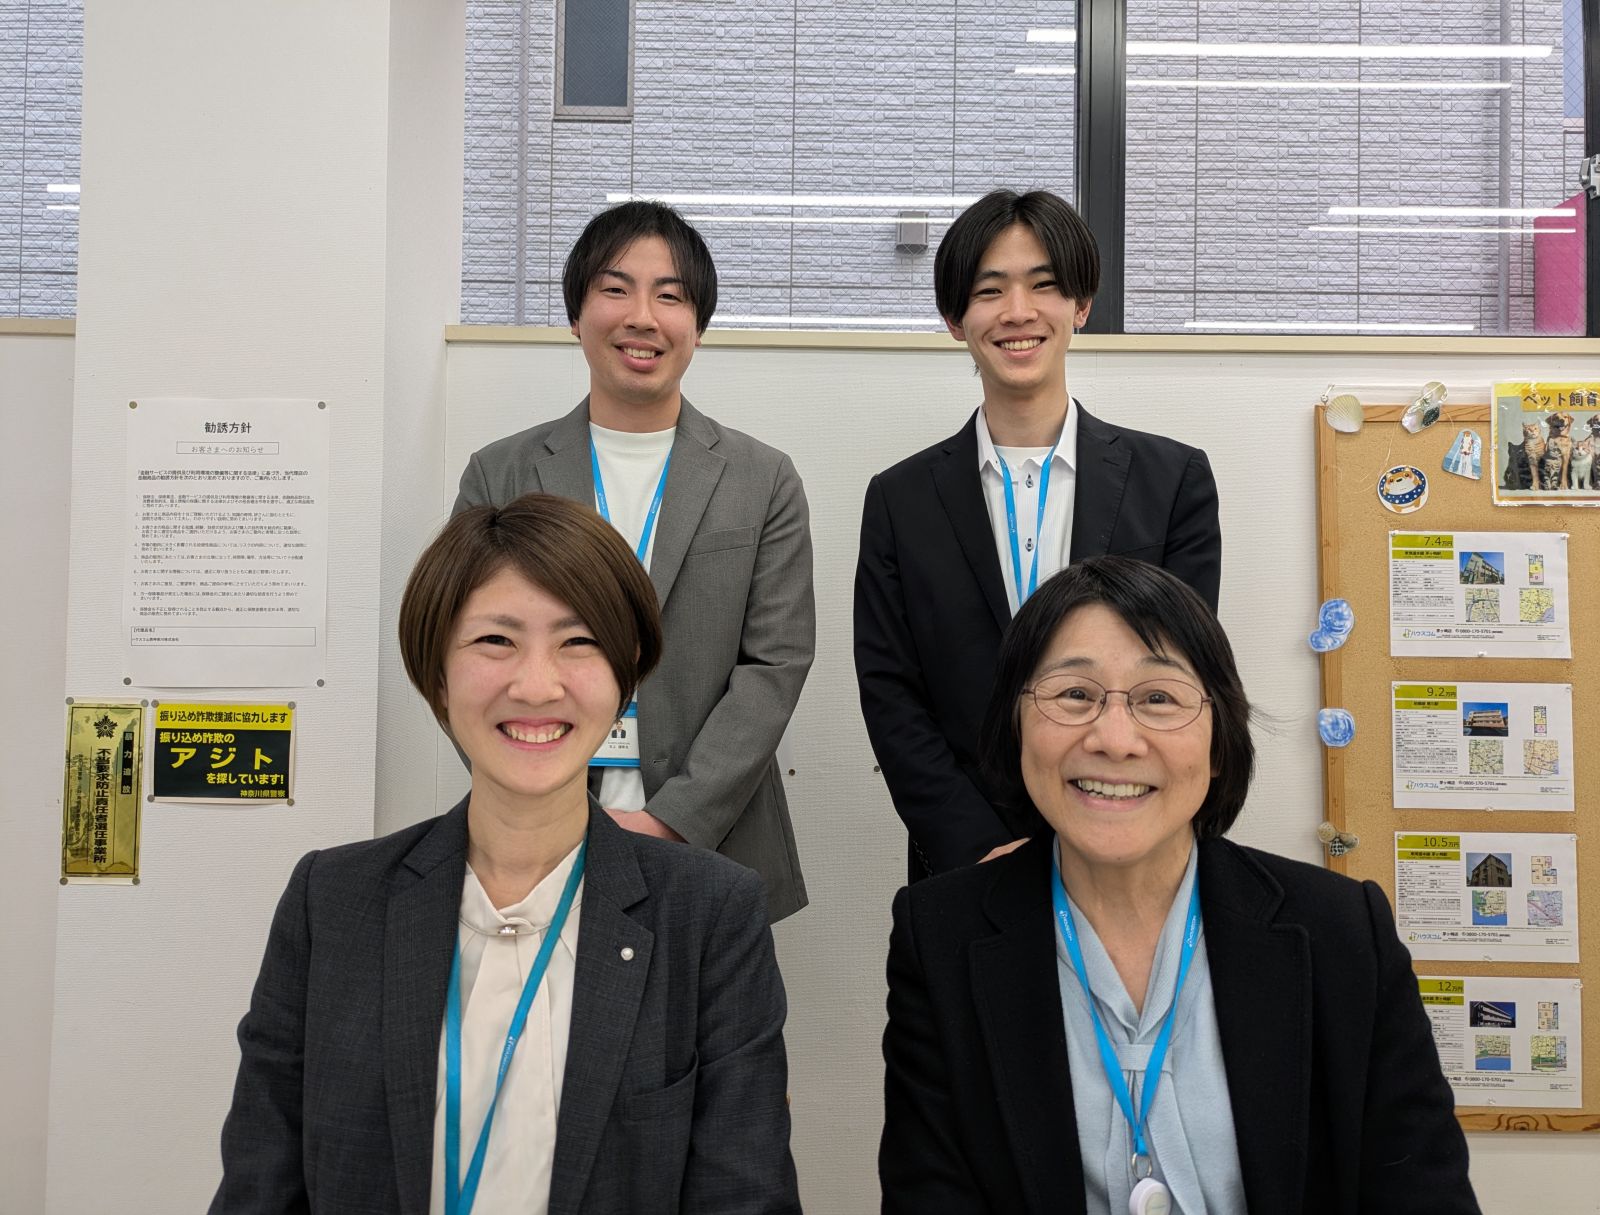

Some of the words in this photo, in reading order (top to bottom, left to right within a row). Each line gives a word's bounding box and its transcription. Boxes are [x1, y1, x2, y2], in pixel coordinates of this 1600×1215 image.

[204, 421, 252, 434] 勧誘方針
[191, 445, 264, 454] お客さまへのお知らせ
[1427, 687, 1456, 697] 9.2万円
[159, 711, 288, 724] 振り込め詐欺撲滅に協力します
[159, 731, 235, 745] 振り込め詐欺の
[170, 747, 273, 771] アジト
[240, 789, 286, 798] 神奈川県警察
[93, 748, 111, 864] 不当要求防止責任者選任事業所
[1438, 981, 1463, 993] 12万円
